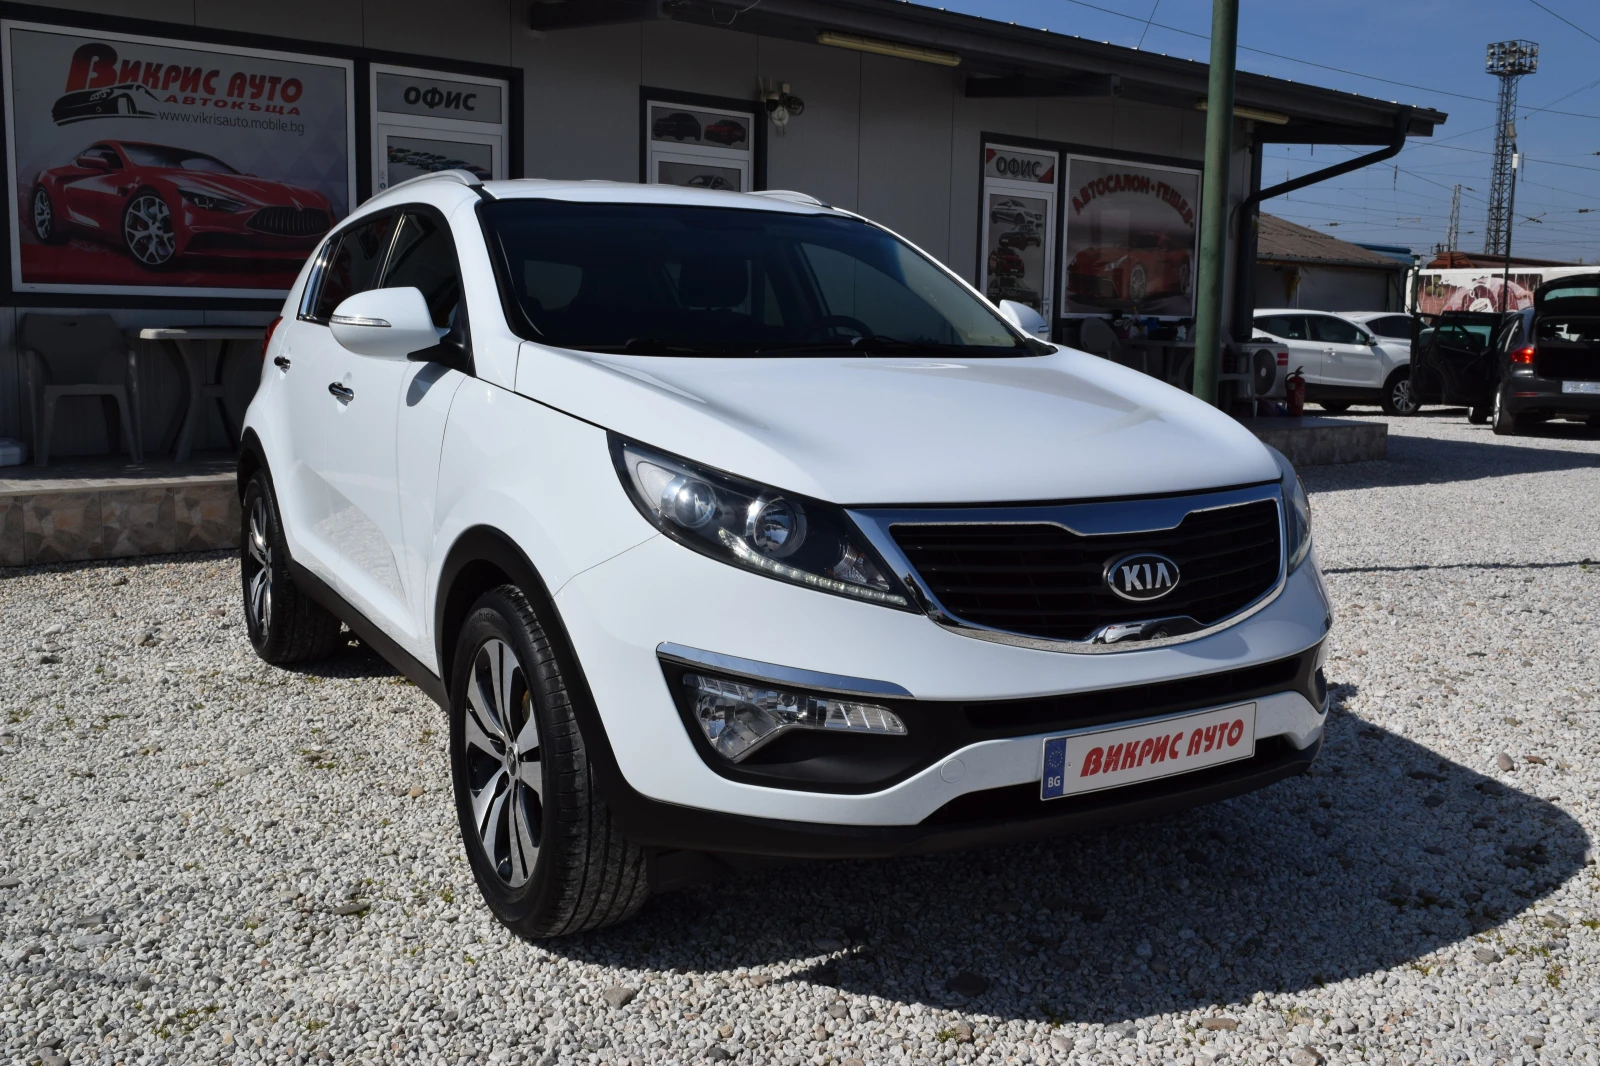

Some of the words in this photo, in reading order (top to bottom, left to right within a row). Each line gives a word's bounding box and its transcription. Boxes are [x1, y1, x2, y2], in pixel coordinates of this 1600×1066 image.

[227, 71, 303, 104] АУТО
[403, 86, 477, 112] ОФИС
[163, 94, 300, 116] АВТОКЪЩА
[159, 110, 305, 136] www.vikrisauto.mobile.bg
[995, 156, 1043, 179] ОФИС
[1121, 562, 1172, 592] KIA
[1080, 731, 1184, 778] ВИКРИС
[1186, 718, 1244, 757] АУТО
[1047, 776, 1061, 788] BG
